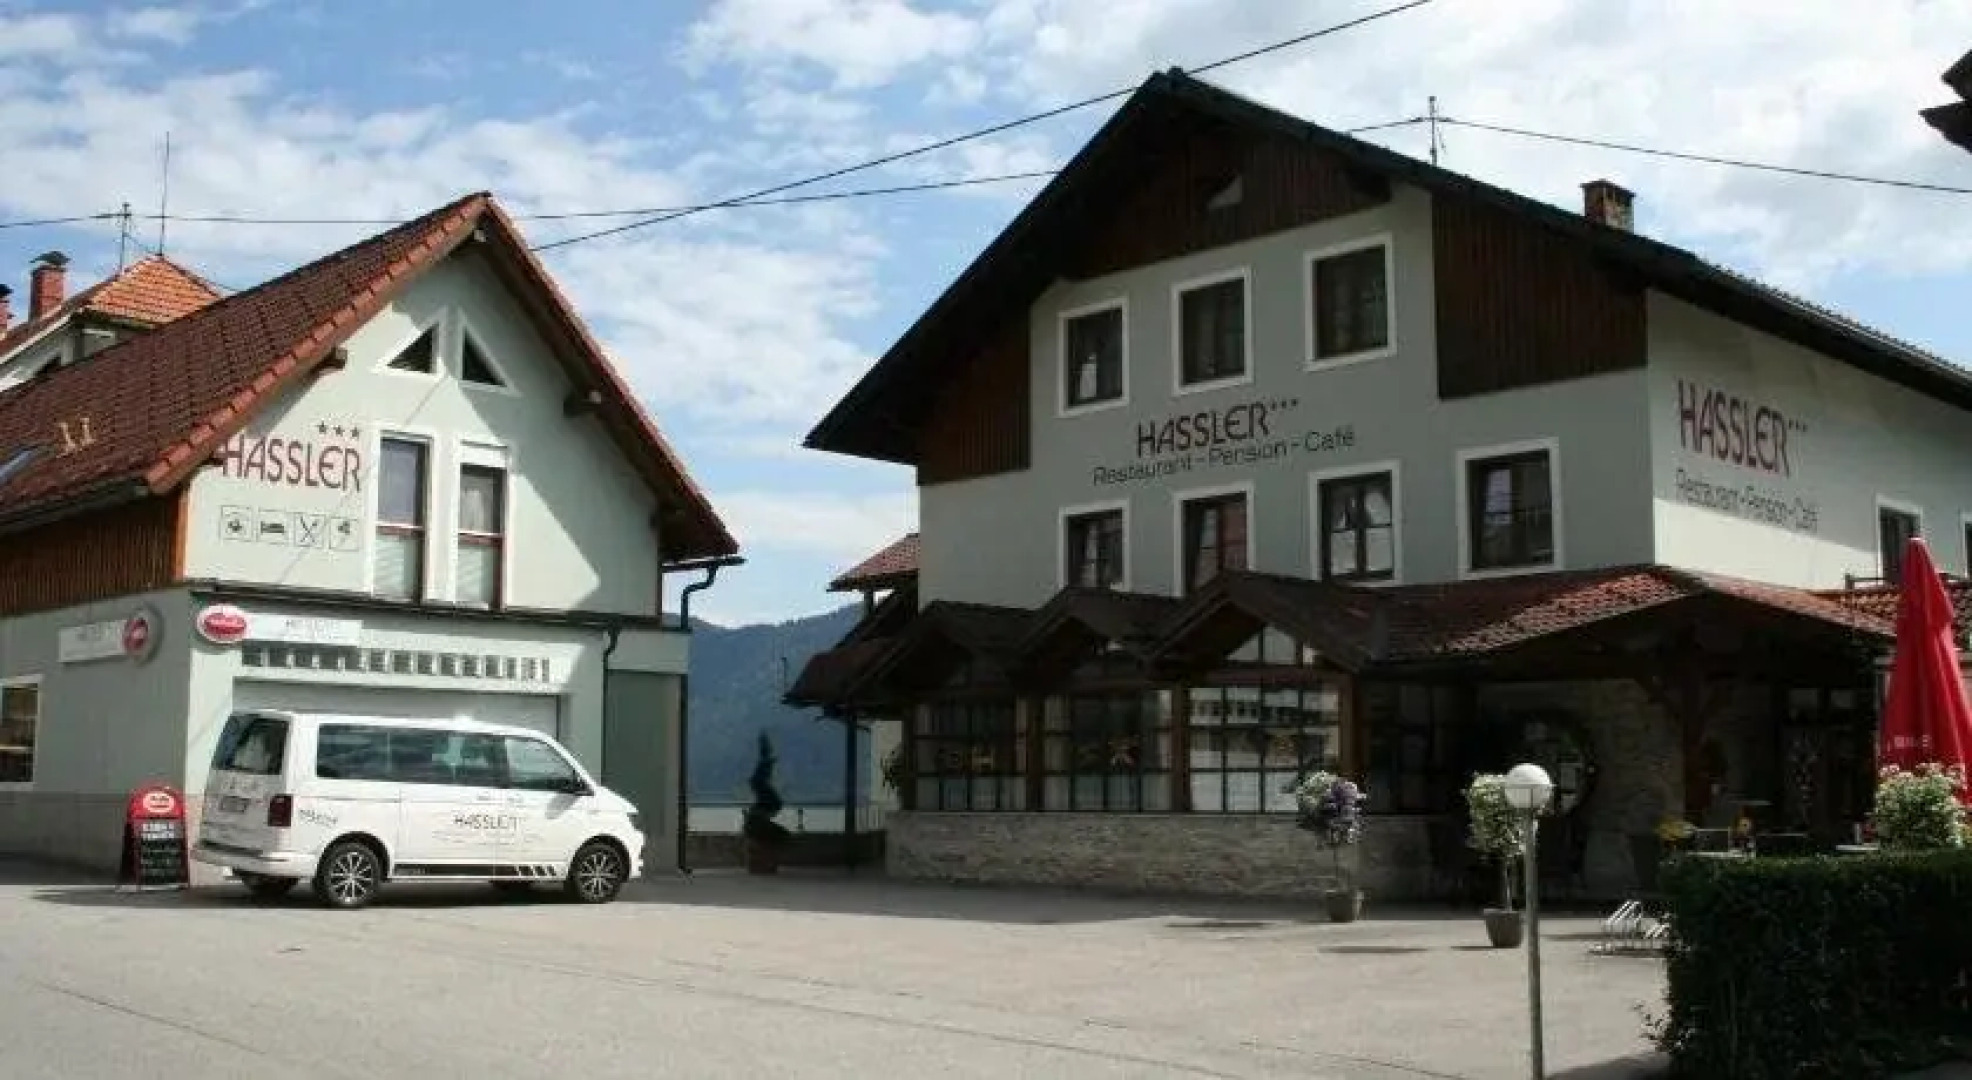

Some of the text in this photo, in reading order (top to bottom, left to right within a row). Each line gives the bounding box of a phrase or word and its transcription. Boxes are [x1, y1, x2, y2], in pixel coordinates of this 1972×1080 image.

[1137, 401, 1270, 459] HASSLER
[1678, 379, 1790, 479] HASSLER
[218, 433, 361, 493] HASSLER
